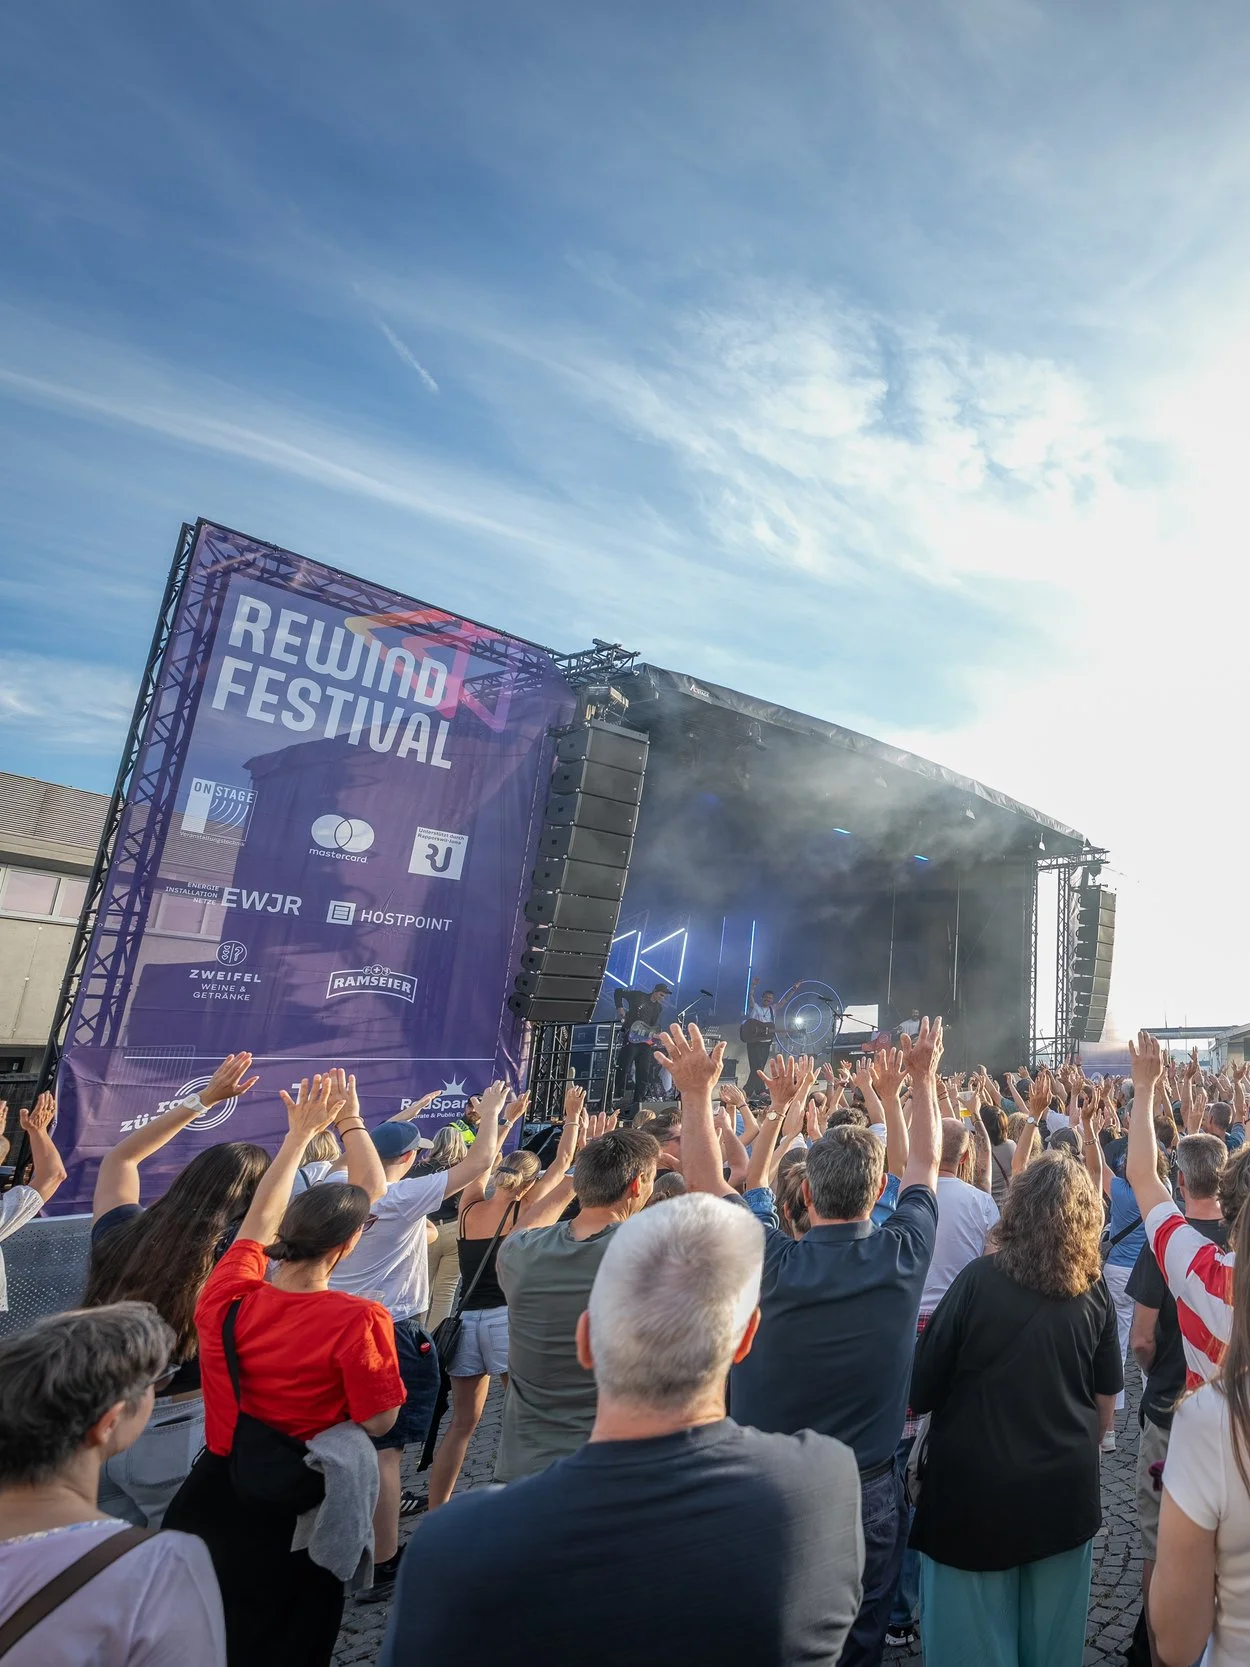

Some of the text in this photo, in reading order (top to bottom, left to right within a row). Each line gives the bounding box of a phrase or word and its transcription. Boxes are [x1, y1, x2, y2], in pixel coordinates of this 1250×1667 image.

[228, 594, 448, 707] REWIND
[211, 655, 452, 770] FESTIVAL
[194, 781, 254, 804] ON STAGE
[165, 886, 219, 899] INSTALLATION
[187, 881, 220, 892] ENERGIE
[192, 897, 217, 906] NETZE
[220, 887, 303, 916] EWJR
[360, 909, 453, 932] HOSTPOINT
[189, 969, 262, 983] ZWEIFEL
[201, 983, 236, 992] WEINE
[333, 975, 412, 994] RAMSEIER
[192, 991, 251, 1001] GETRÄNKE
